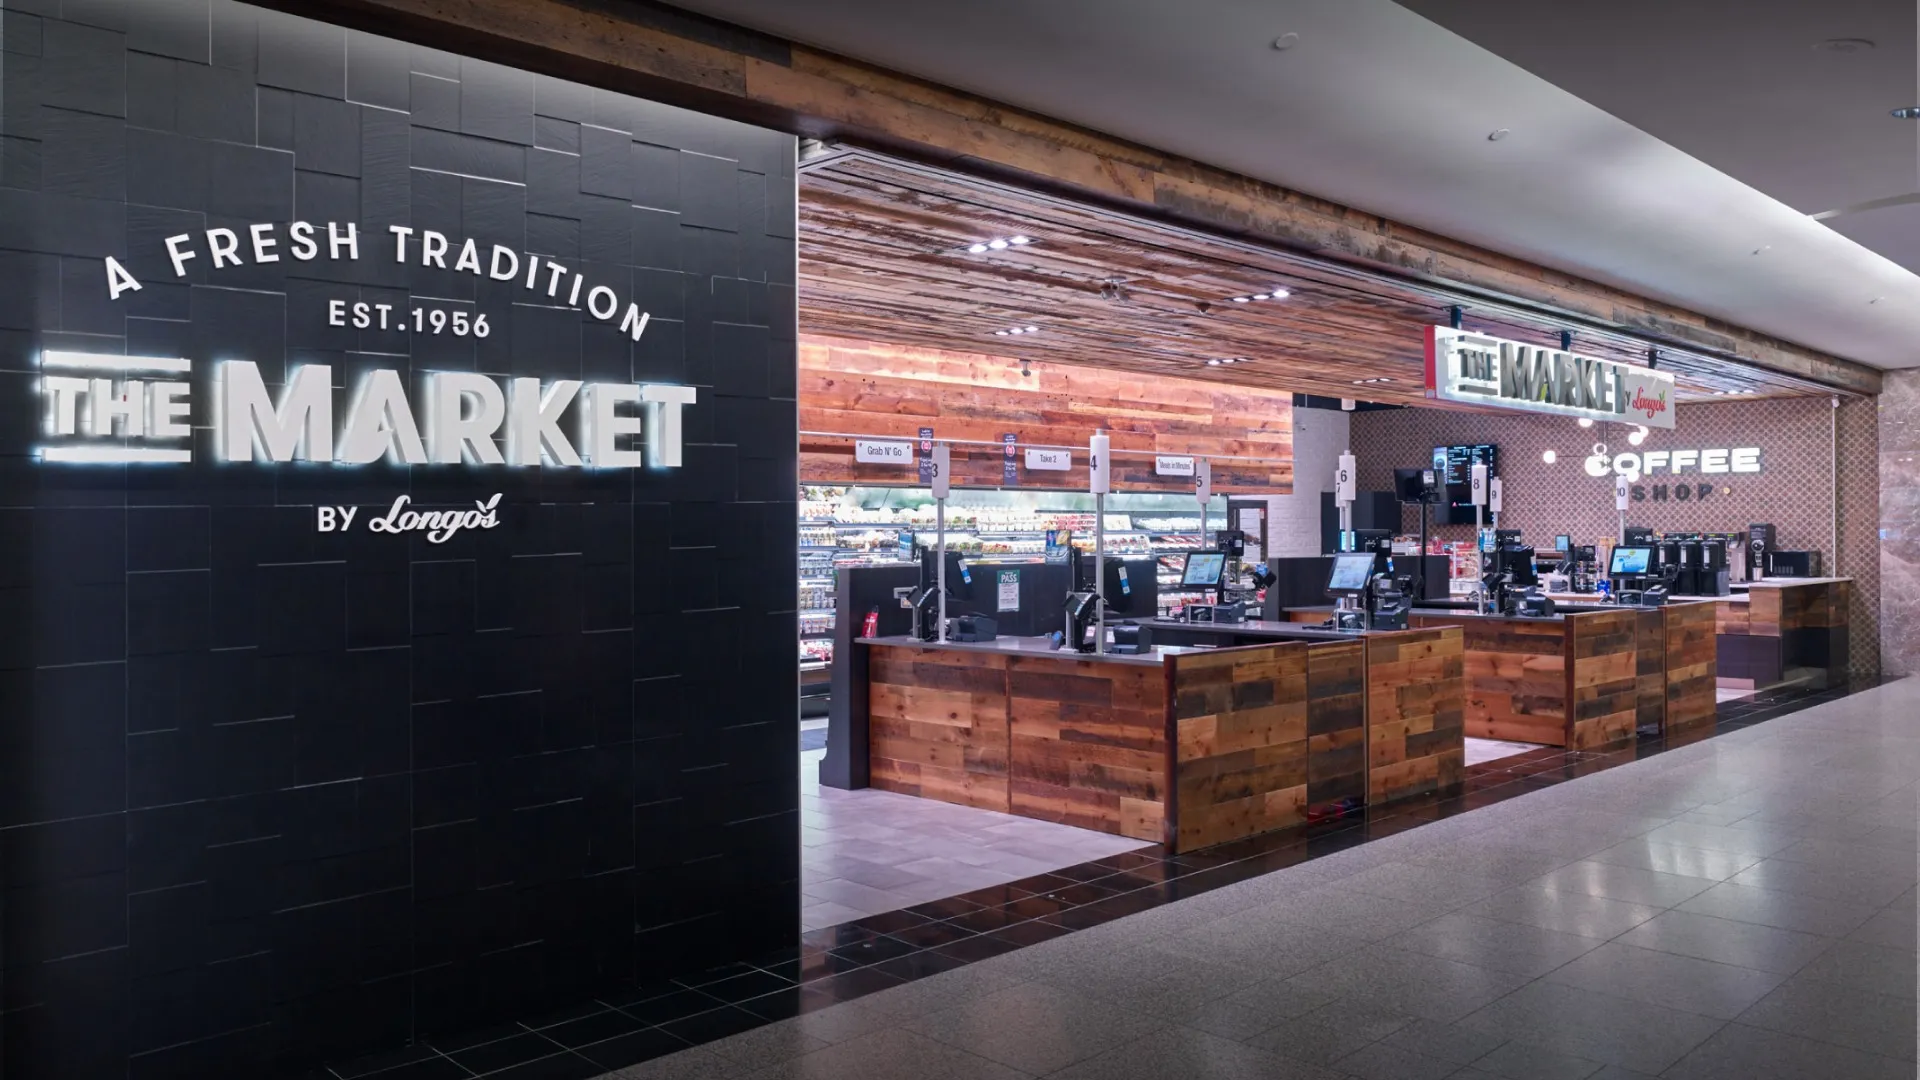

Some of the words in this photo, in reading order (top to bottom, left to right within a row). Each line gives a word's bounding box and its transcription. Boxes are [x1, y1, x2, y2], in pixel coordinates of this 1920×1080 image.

[105, 256, 142, 301] A
[164, 221, 360, 278] FRESH
[389, 226, 651, 342] TRADITION
[1457, 348, 1497, 382] THE
[1500, 342, 1628, 414] MARKET
[42, 376, 192, 438] THE
[218, 360, 697, 468] MARKET
[867, 446, 883, 456] Grab
[893, 447, 902, 457] Go
[1040, 454, 1051, 463] Take
[1052, 455, 1057, 463] 2
[1090, 455, 1097, 471] 4
[1585, 447, 1761, 477] COFFEE
[932, 463, 938, 478] 3
[1340, 469, 1348, 483] 6
[1196, 475, 1203, 488] 5
[1473, 478, 1480, 490] 8
[1491, 490, 1497, 499] 9
[1631, 484, 1713, 500] SHOP
[317, 506, 357, 533] BY
[1001, 574, 1017, 583] PASS
